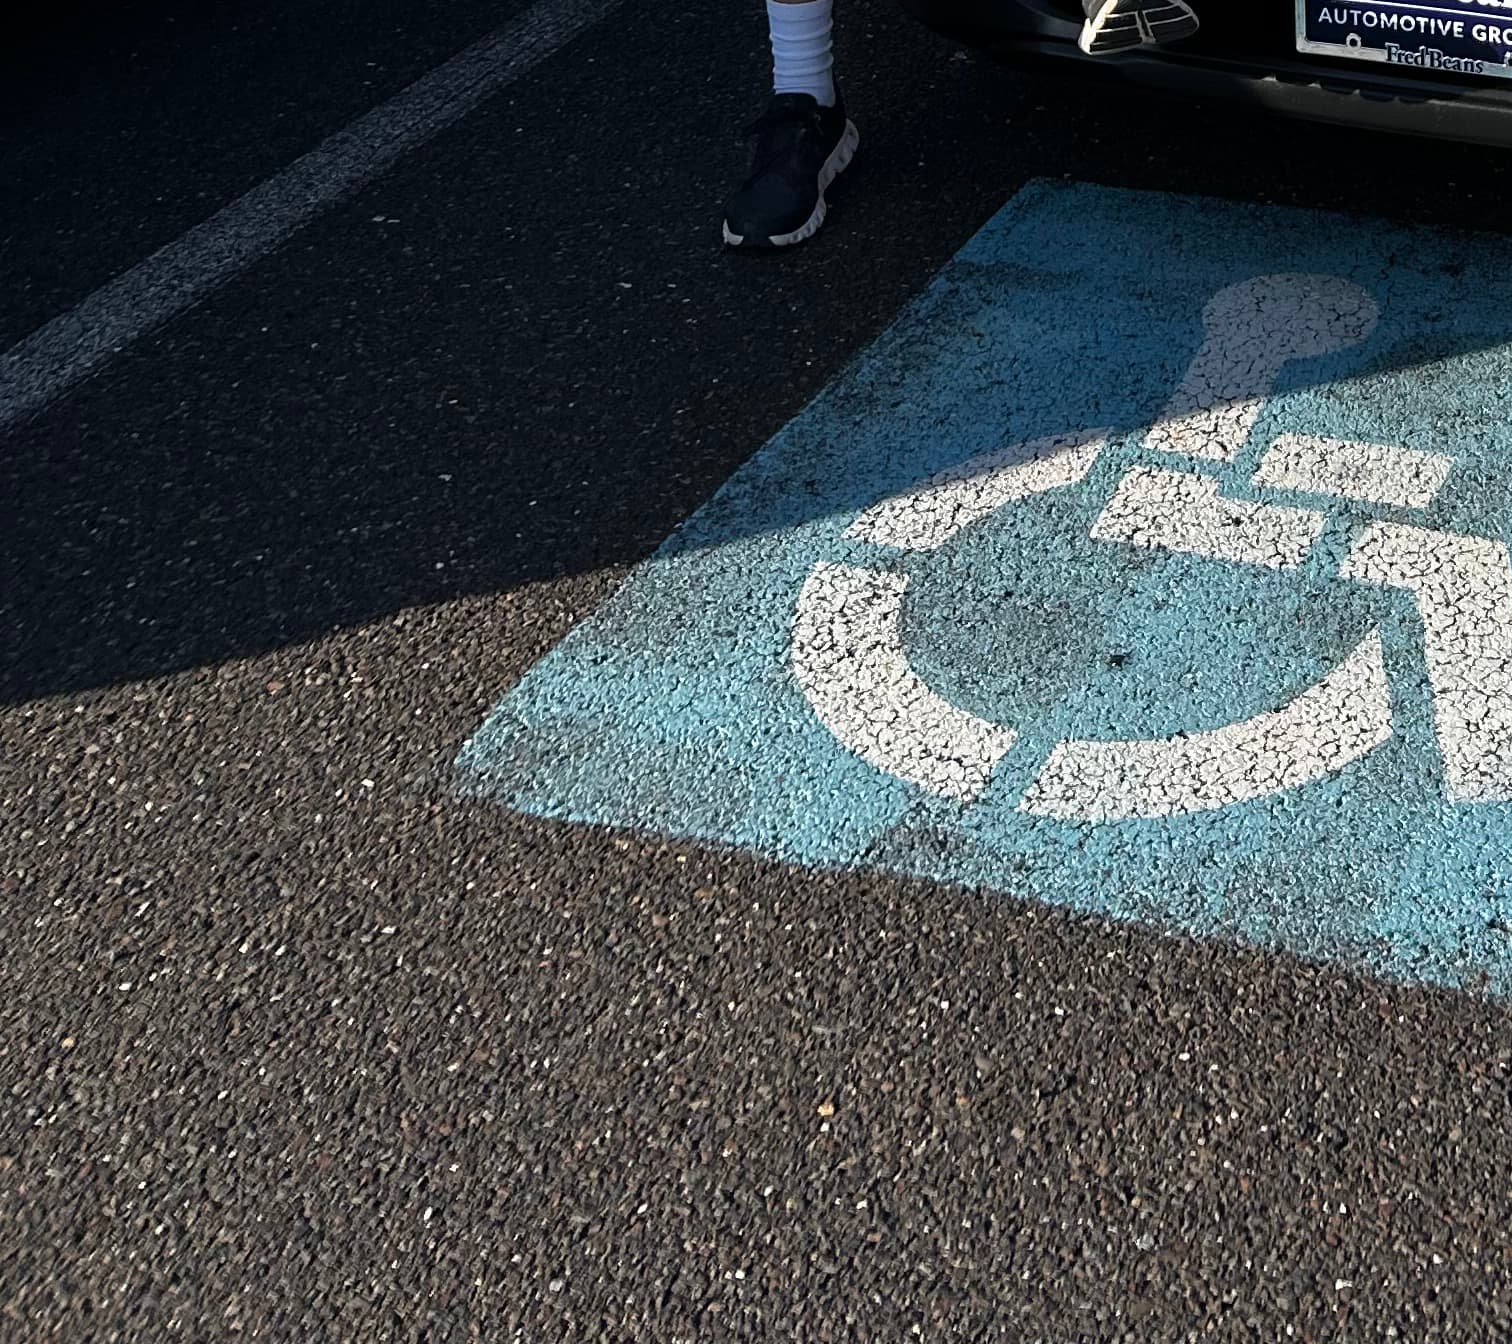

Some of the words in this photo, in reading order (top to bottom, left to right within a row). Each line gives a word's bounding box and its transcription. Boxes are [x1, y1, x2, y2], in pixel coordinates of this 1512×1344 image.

[1318, 6, 1465, 39] AUTOMOTIVE
[1384, 41, 1426, 67] Fred
[1426, 47, 1484, 74] Beans
